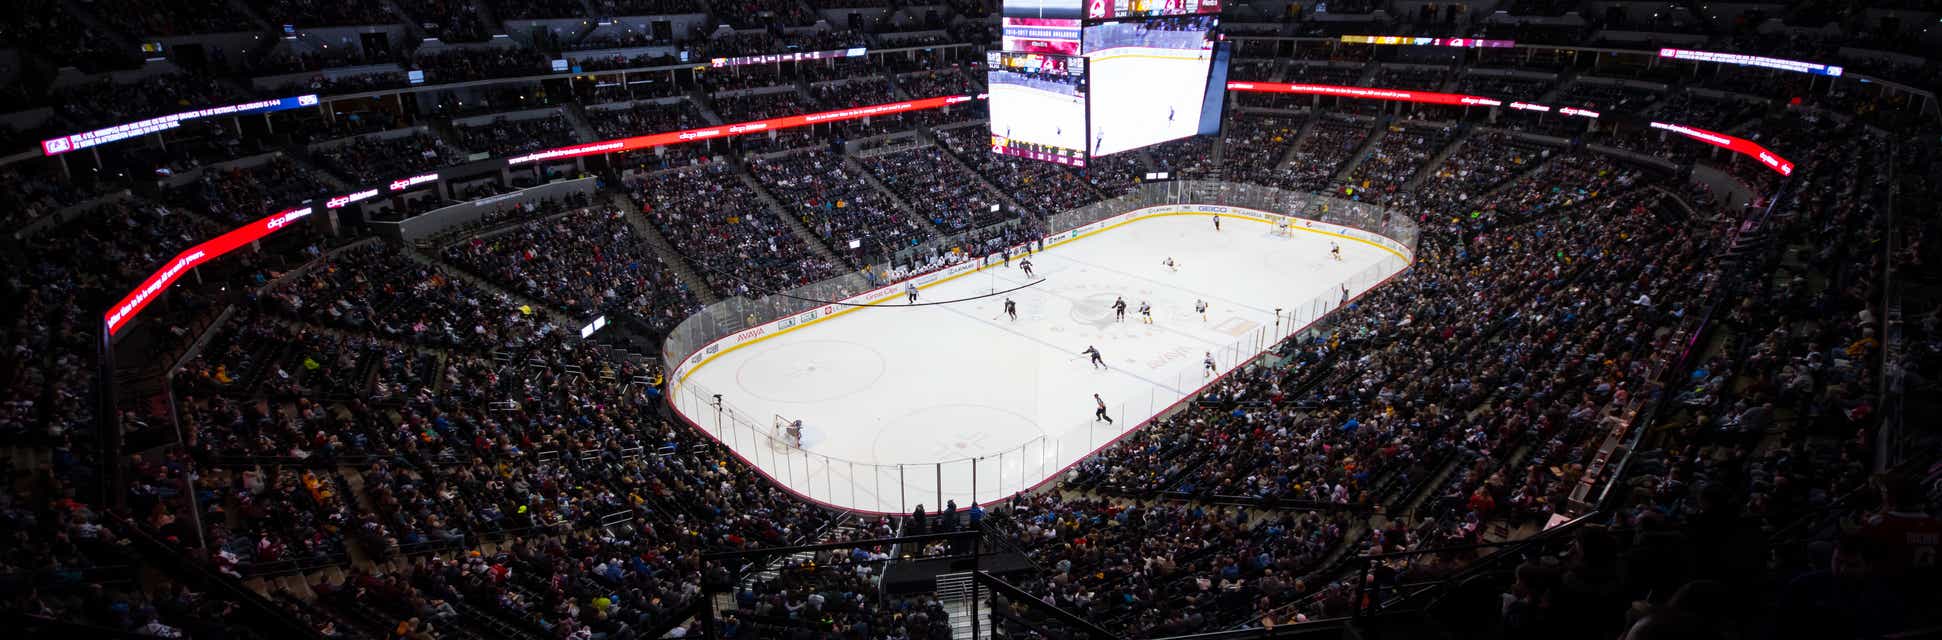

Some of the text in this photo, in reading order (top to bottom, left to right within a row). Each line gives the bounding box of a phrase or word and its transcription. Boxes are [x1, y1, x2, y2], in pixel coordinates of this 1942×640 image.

[390, 180, 409, 190] dcp
[326, 197, 349, 208] dcp
[268, 217, 285, 229] dcp
[736, 327, 765, 342] AVAYA
